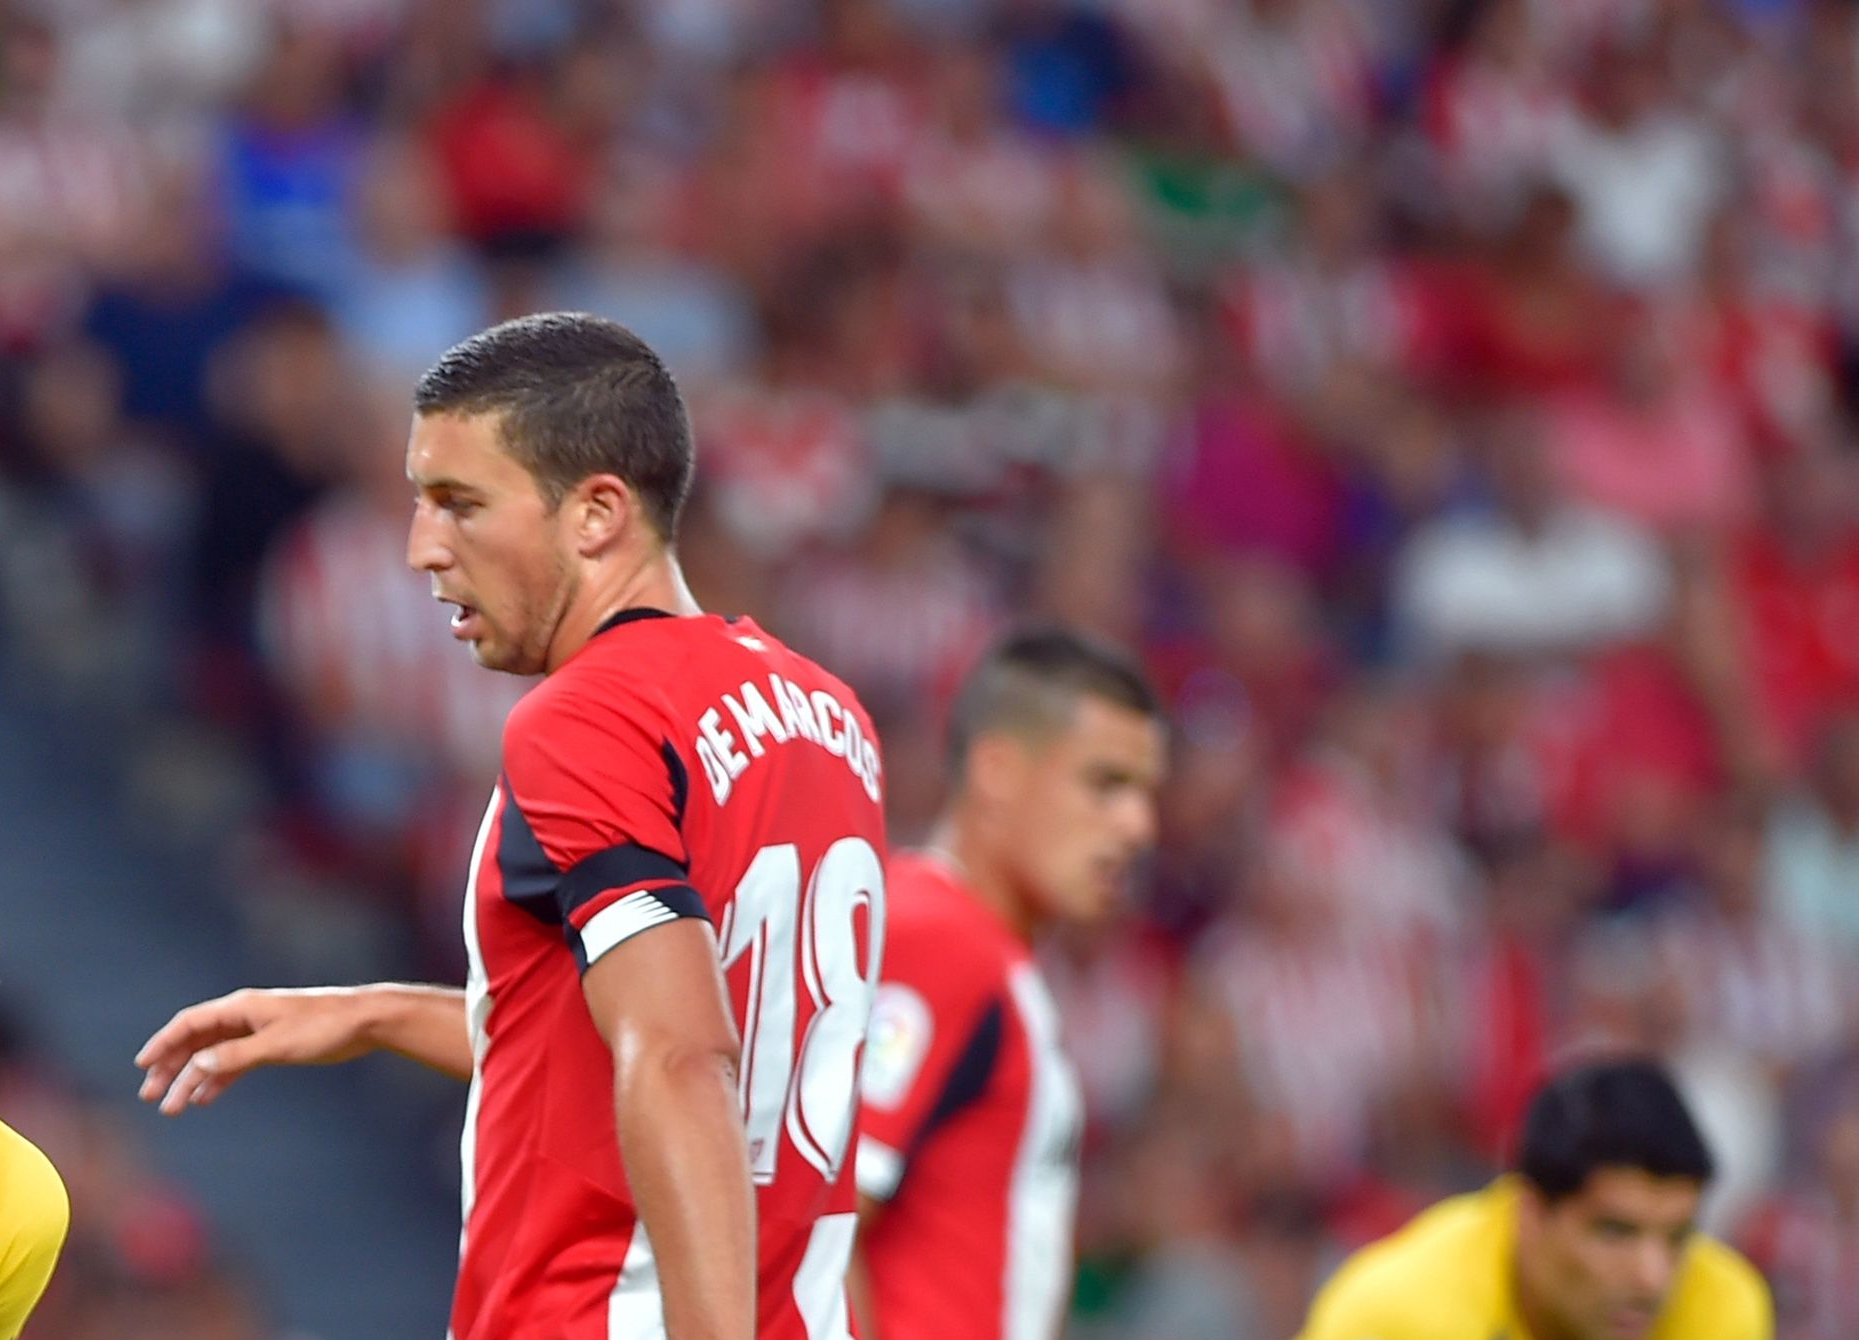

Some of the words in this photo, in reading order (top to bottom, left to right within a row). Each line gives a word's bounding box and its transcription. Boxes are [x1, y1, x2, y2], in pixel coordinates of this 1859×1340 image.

[695, 706, 750, 808] DE
[720, 672, 883, 804] MARCOS
[718, 835, 887, 1185] 18
